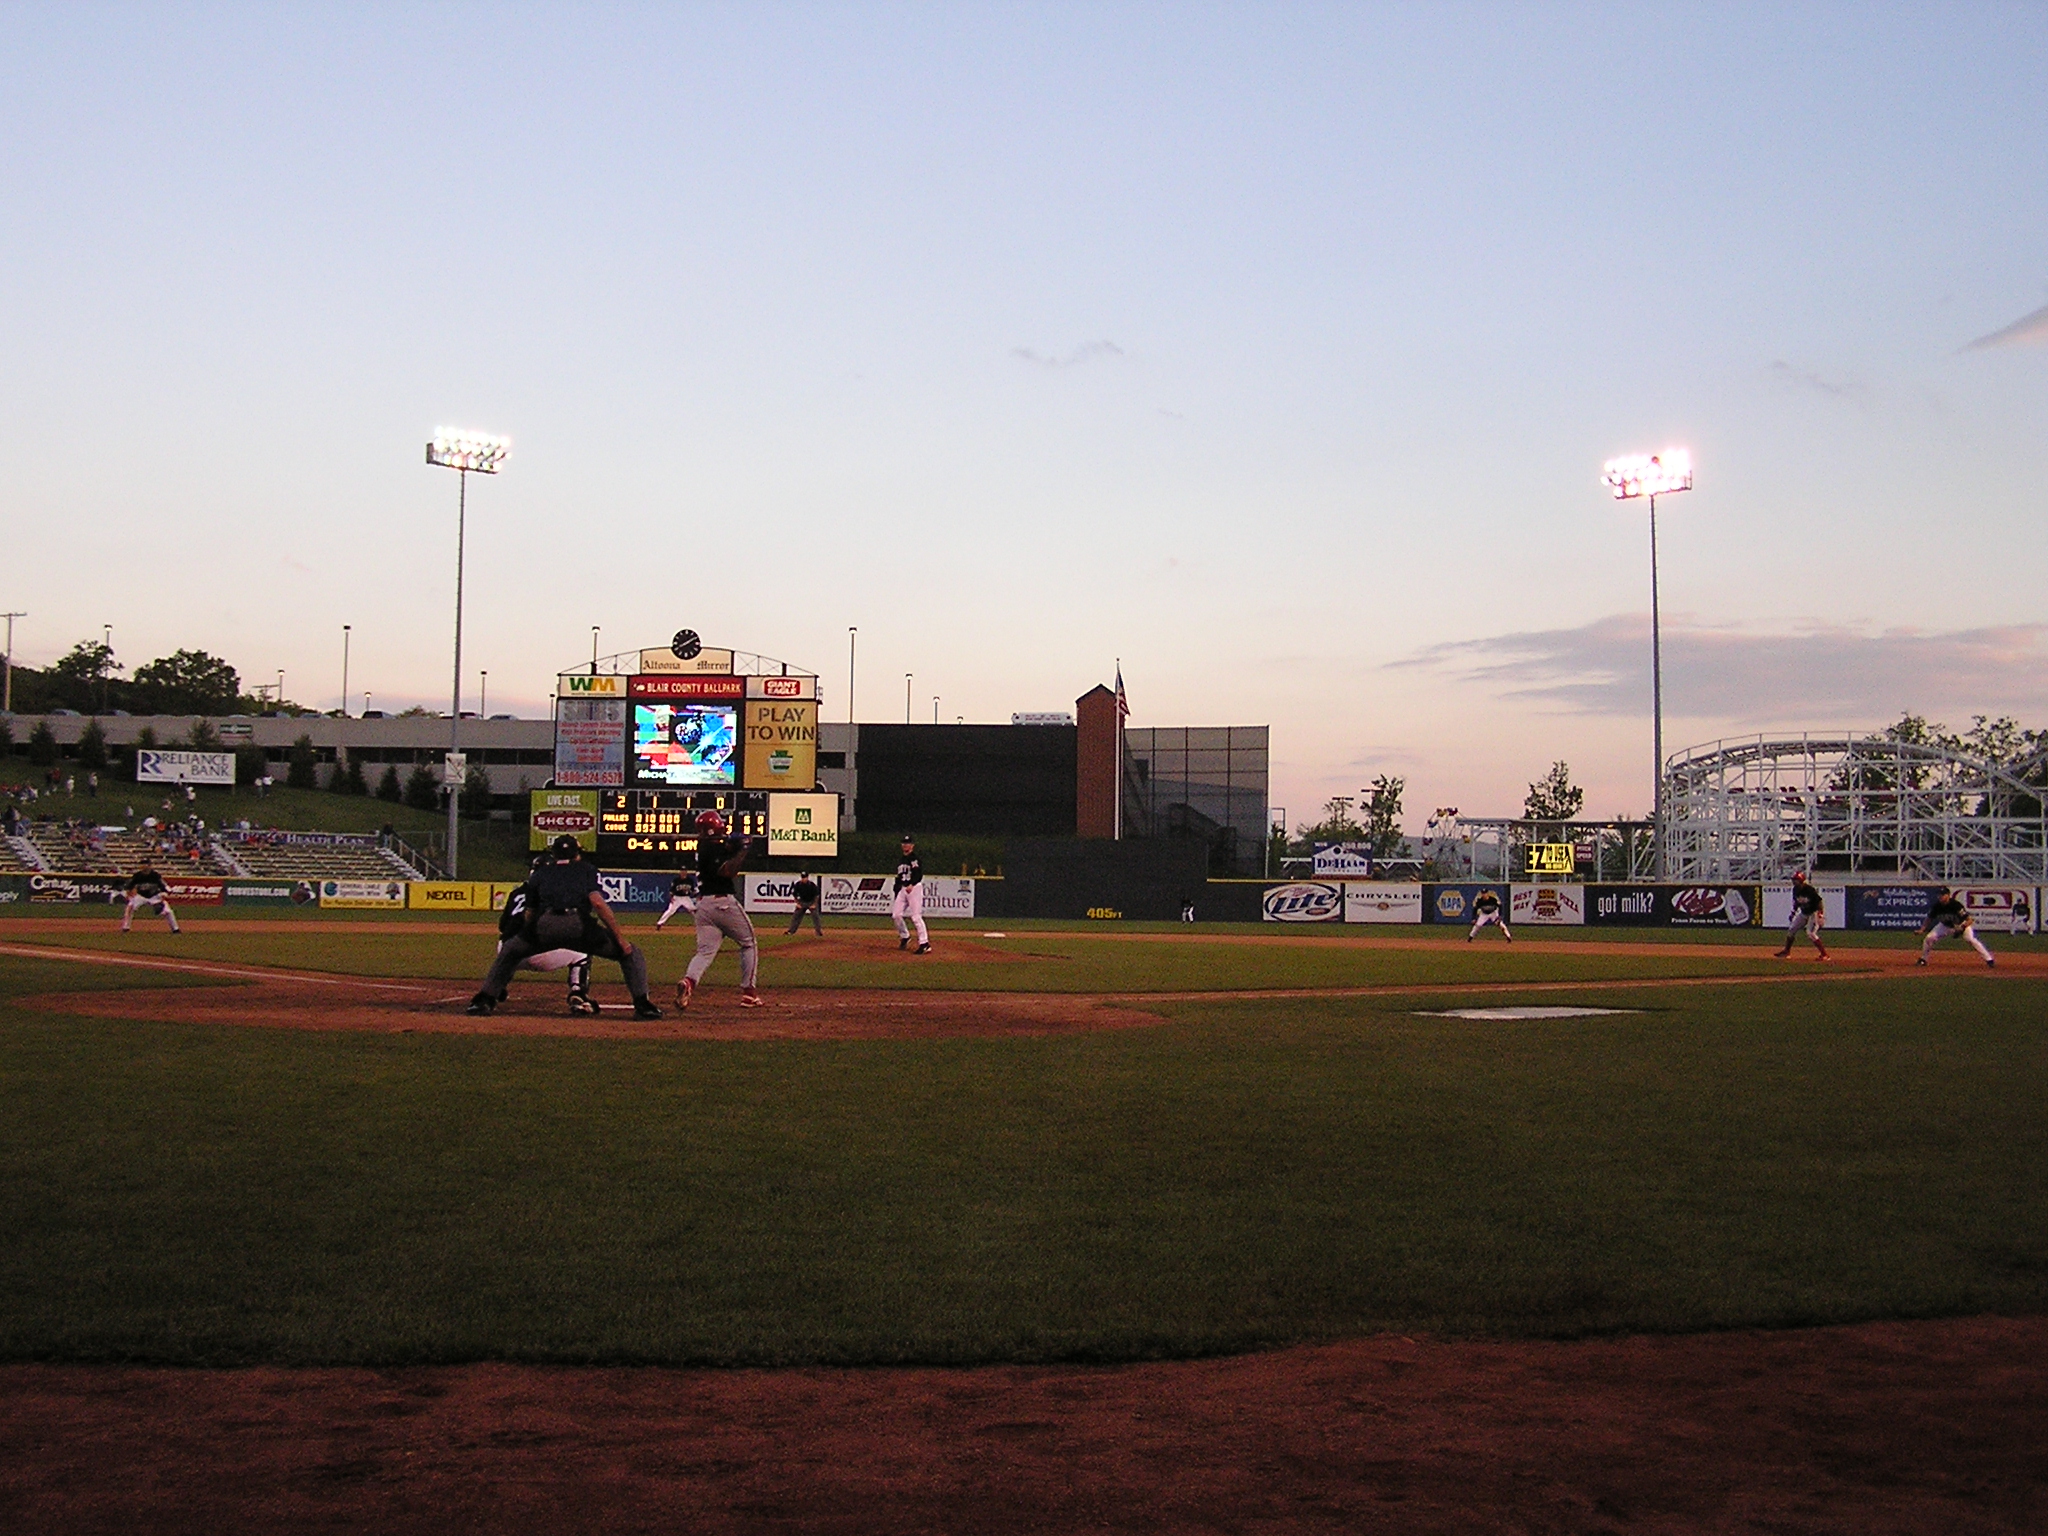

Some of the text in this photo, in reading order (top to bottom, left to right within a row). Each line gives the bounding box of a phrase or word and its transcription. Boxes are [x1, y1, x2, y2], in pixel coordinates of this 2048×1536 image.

[643, 660, 729, 670] Altoona Mirror
[570, 678, 616, 691] WM
[647, 682, 741, 693] BLAIR COUNTY BALLPARK
[767, 687, 797, 695] EAGLE
[758, 708, 805, 722] PLAY
[747, 726, 815, 740] TO WIN
[162, 753, 228, 766] RELIANCE
[191, 764, 229, 776] BANK
[617, 796, 724, 809] 2 1 1 0
[537, 817, 591, 826] SHEETZ
[334, 834, 364, 845] PLAN
[770, 828, 836, 842] M&T Bank
[30, 875, 72, 890] Century
[757, 880, 795, 897] CiNTA
[426, 890, 467, 901] NEXTEL
[601, 877, 665, 903] S&T Bank
[825, 892, 851, 900] Leonard
[861, 892, 878, 900] Fiore
[879, 892, 892, 900] Inc.
[1513, 890, 1533, 902] BEST
[922, 898, 970, 909] rniture
[1270, 893, 1336, 914] Lite
[1441, 897, 1462, 910] NAPA
[1598, 893, 1617, 917] got
[1621, 892, 1654, 913] milk?
[1877, 898, 1928, 906] EXPRESS
